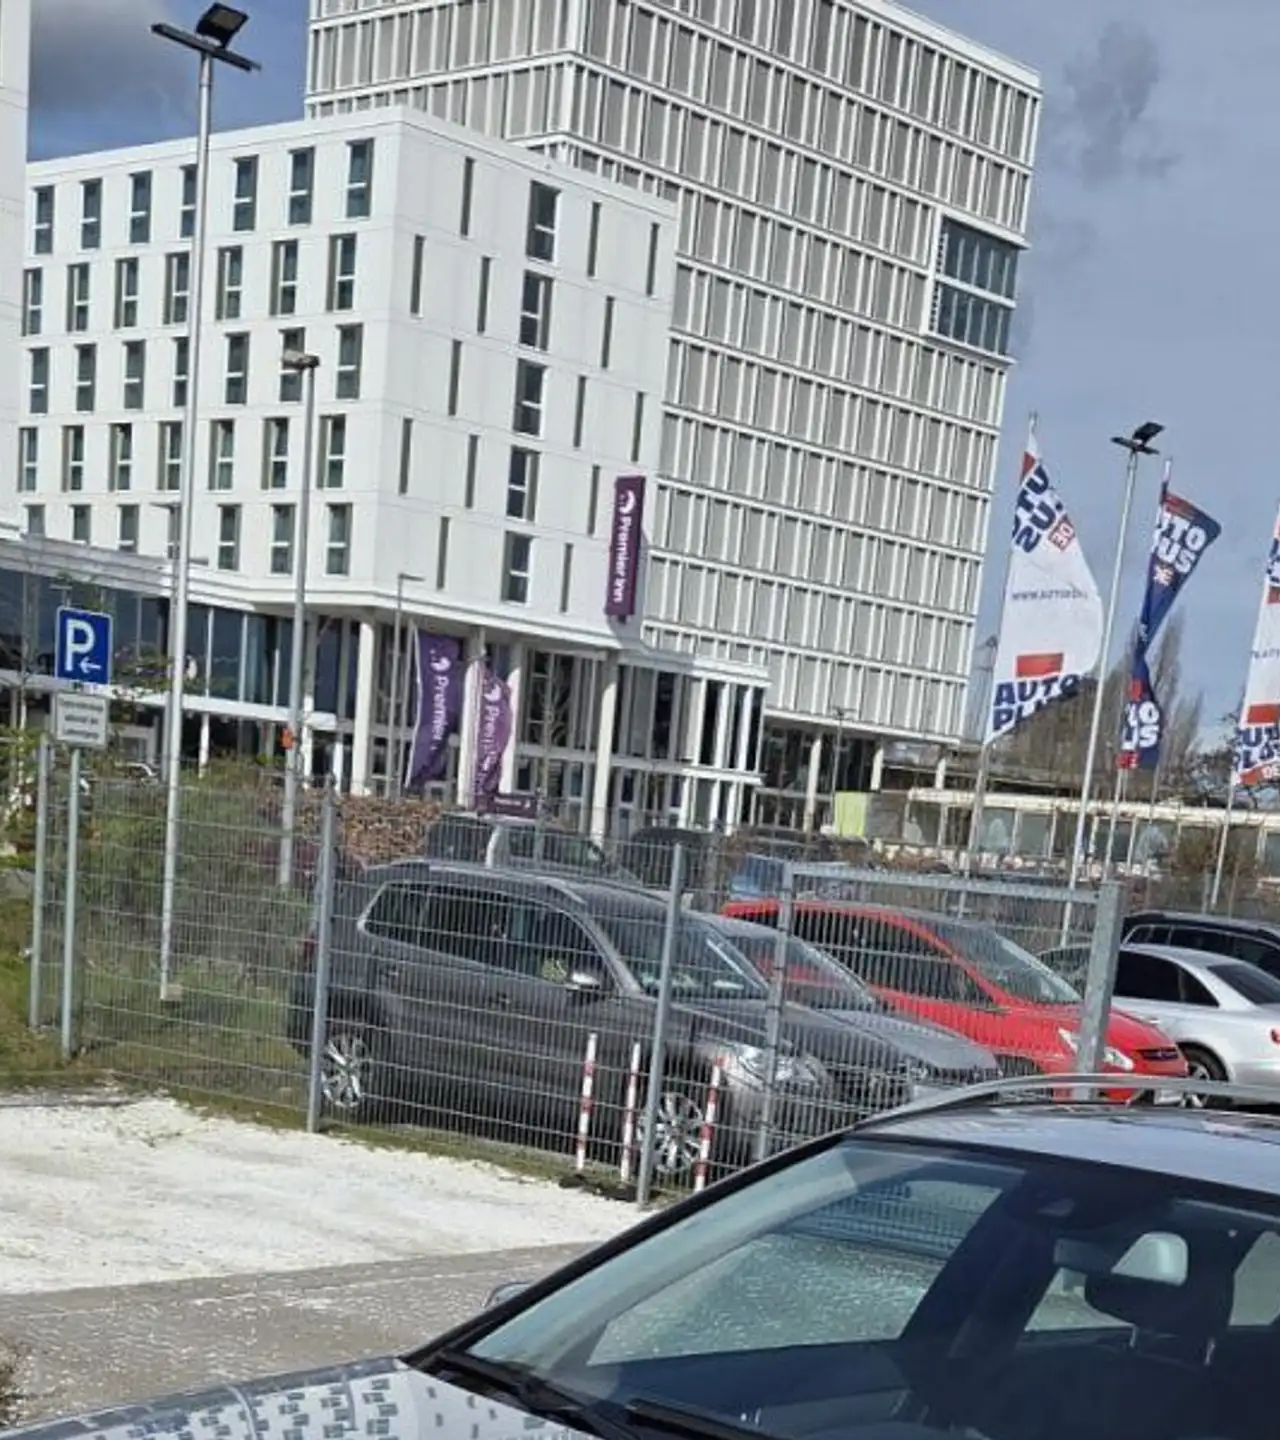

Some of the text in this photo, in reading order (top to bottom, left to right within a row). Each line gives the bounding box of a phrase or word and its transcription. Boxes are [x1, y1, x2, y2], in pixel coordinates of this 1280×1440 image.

[612, 515, 632, 602] Premier Inn
[65, 618, 95, 672] P
